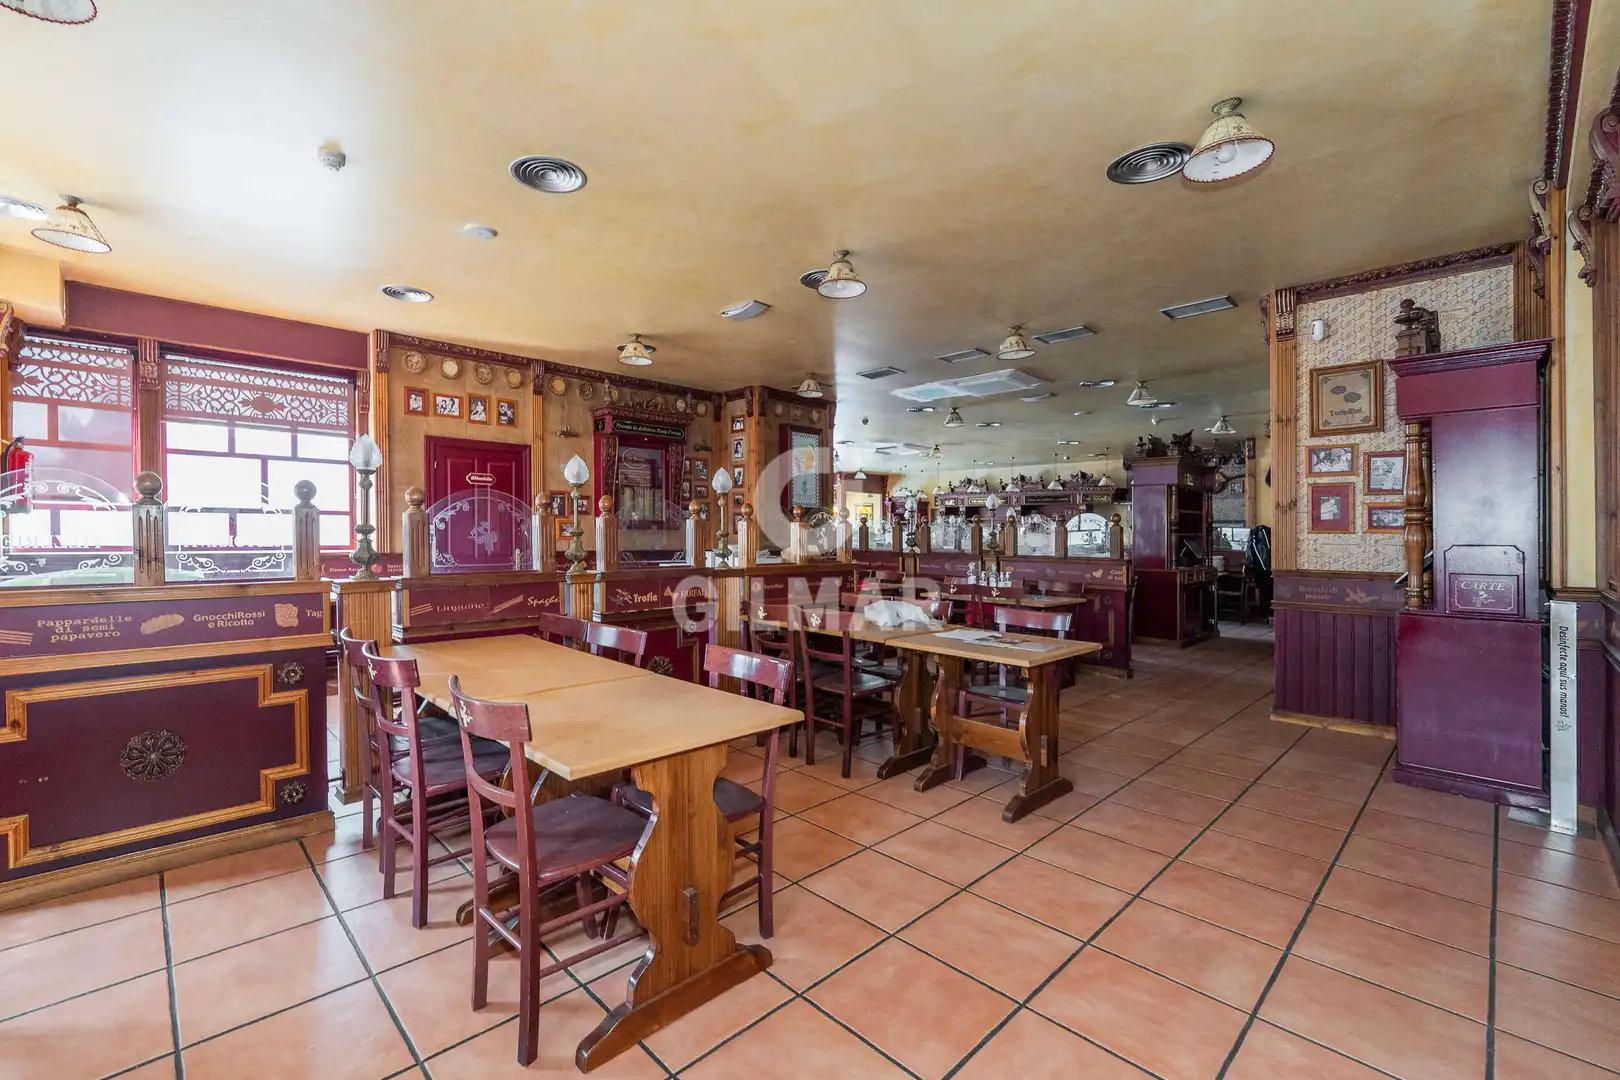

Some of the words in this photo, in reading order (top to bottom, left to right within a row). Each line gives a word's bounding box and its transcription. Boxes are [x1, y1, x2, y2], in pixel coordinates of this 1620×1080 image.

[1461, 581, 1506, 591] CARTE
[633, 592, 658, 602] Trofie
[55, 625, 72, 634] di
[82, 623, 115, 632] semi
[217, 618, 254, 628] Ricotta
[50, 631, 121, 643] papavero
[1557, 626, 1569, 661] Desinfecte
[1559, 679, 1568, 692] sus
